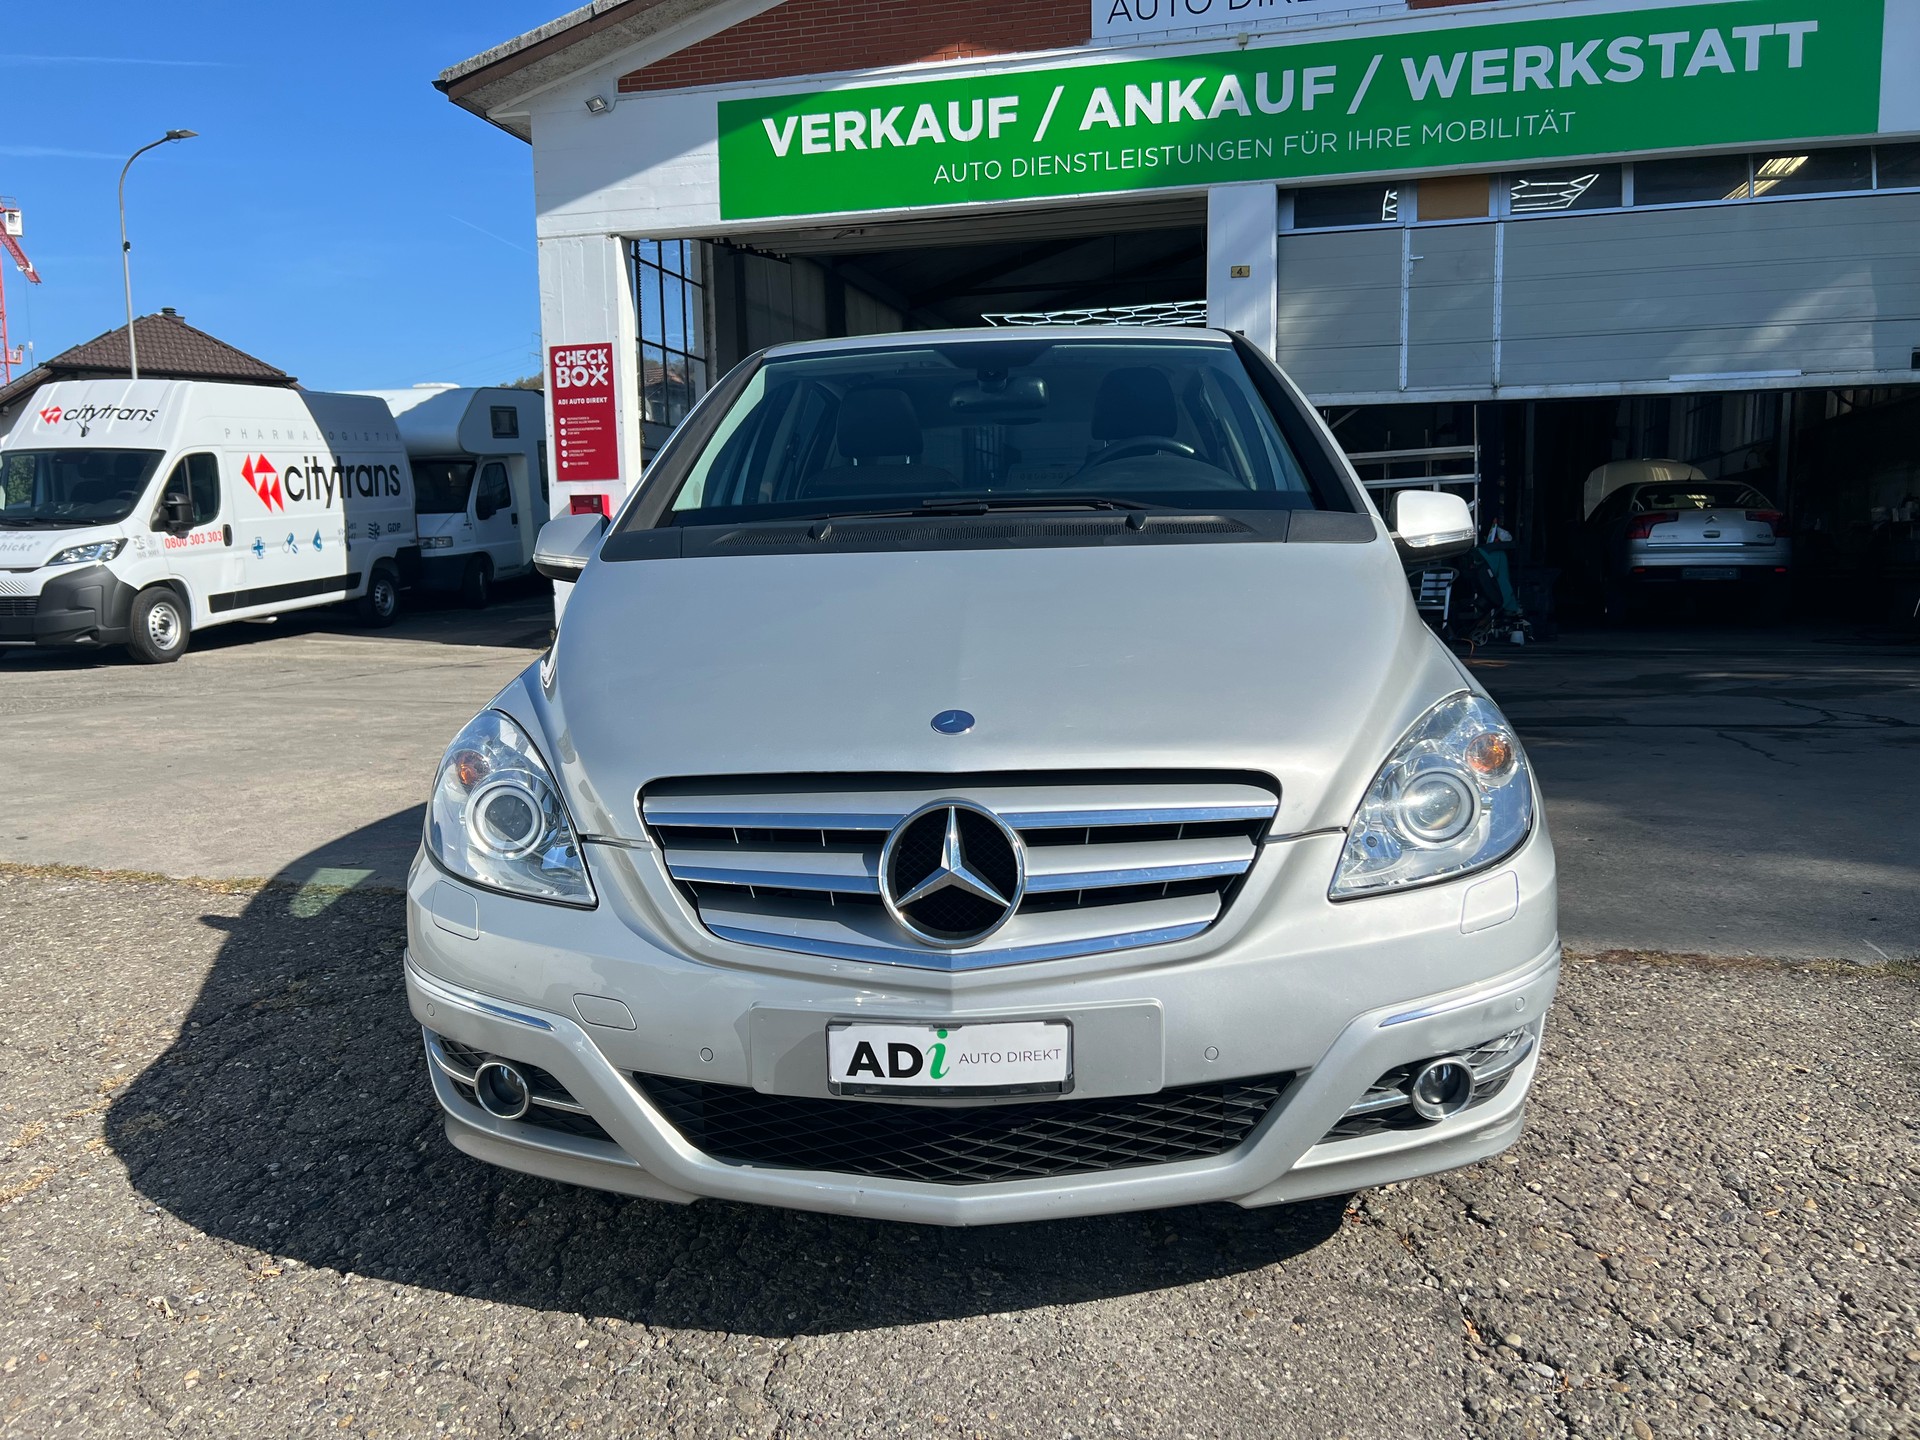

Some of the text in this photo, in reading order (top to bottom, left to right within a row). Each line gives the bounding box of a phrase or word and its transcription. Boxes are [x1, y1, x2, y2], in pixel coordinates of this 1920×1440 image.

[761, 20, 1819, 157] VERKAUF / ANKAUF / WERKSTATT
[933, 110, 1576, 185] AUTO DIENSTLEISTUNGEN FÜR IHRE MOBILITÄT
[1236, 267, 1244, 276] 4
[555, 349, 608, 366] CHECK
[556, 365, 609, 388] BOX
[569, 397, 585, 405] AUTO
[586, 396, 608, 404] DIREKT
[63, 403, 159, 422] citytrans
[284, 455, 402, 509] citytrans
[387, 522, 402, 533] GDP
[165, 537, 188, 549] 0800
[190, 534, 206, 545] 303
[208, 531, 223, 542] 303
[958, 1052, 1002, 1064] AUTO
[1007, 1048, 1062, 1063] DIREKT
